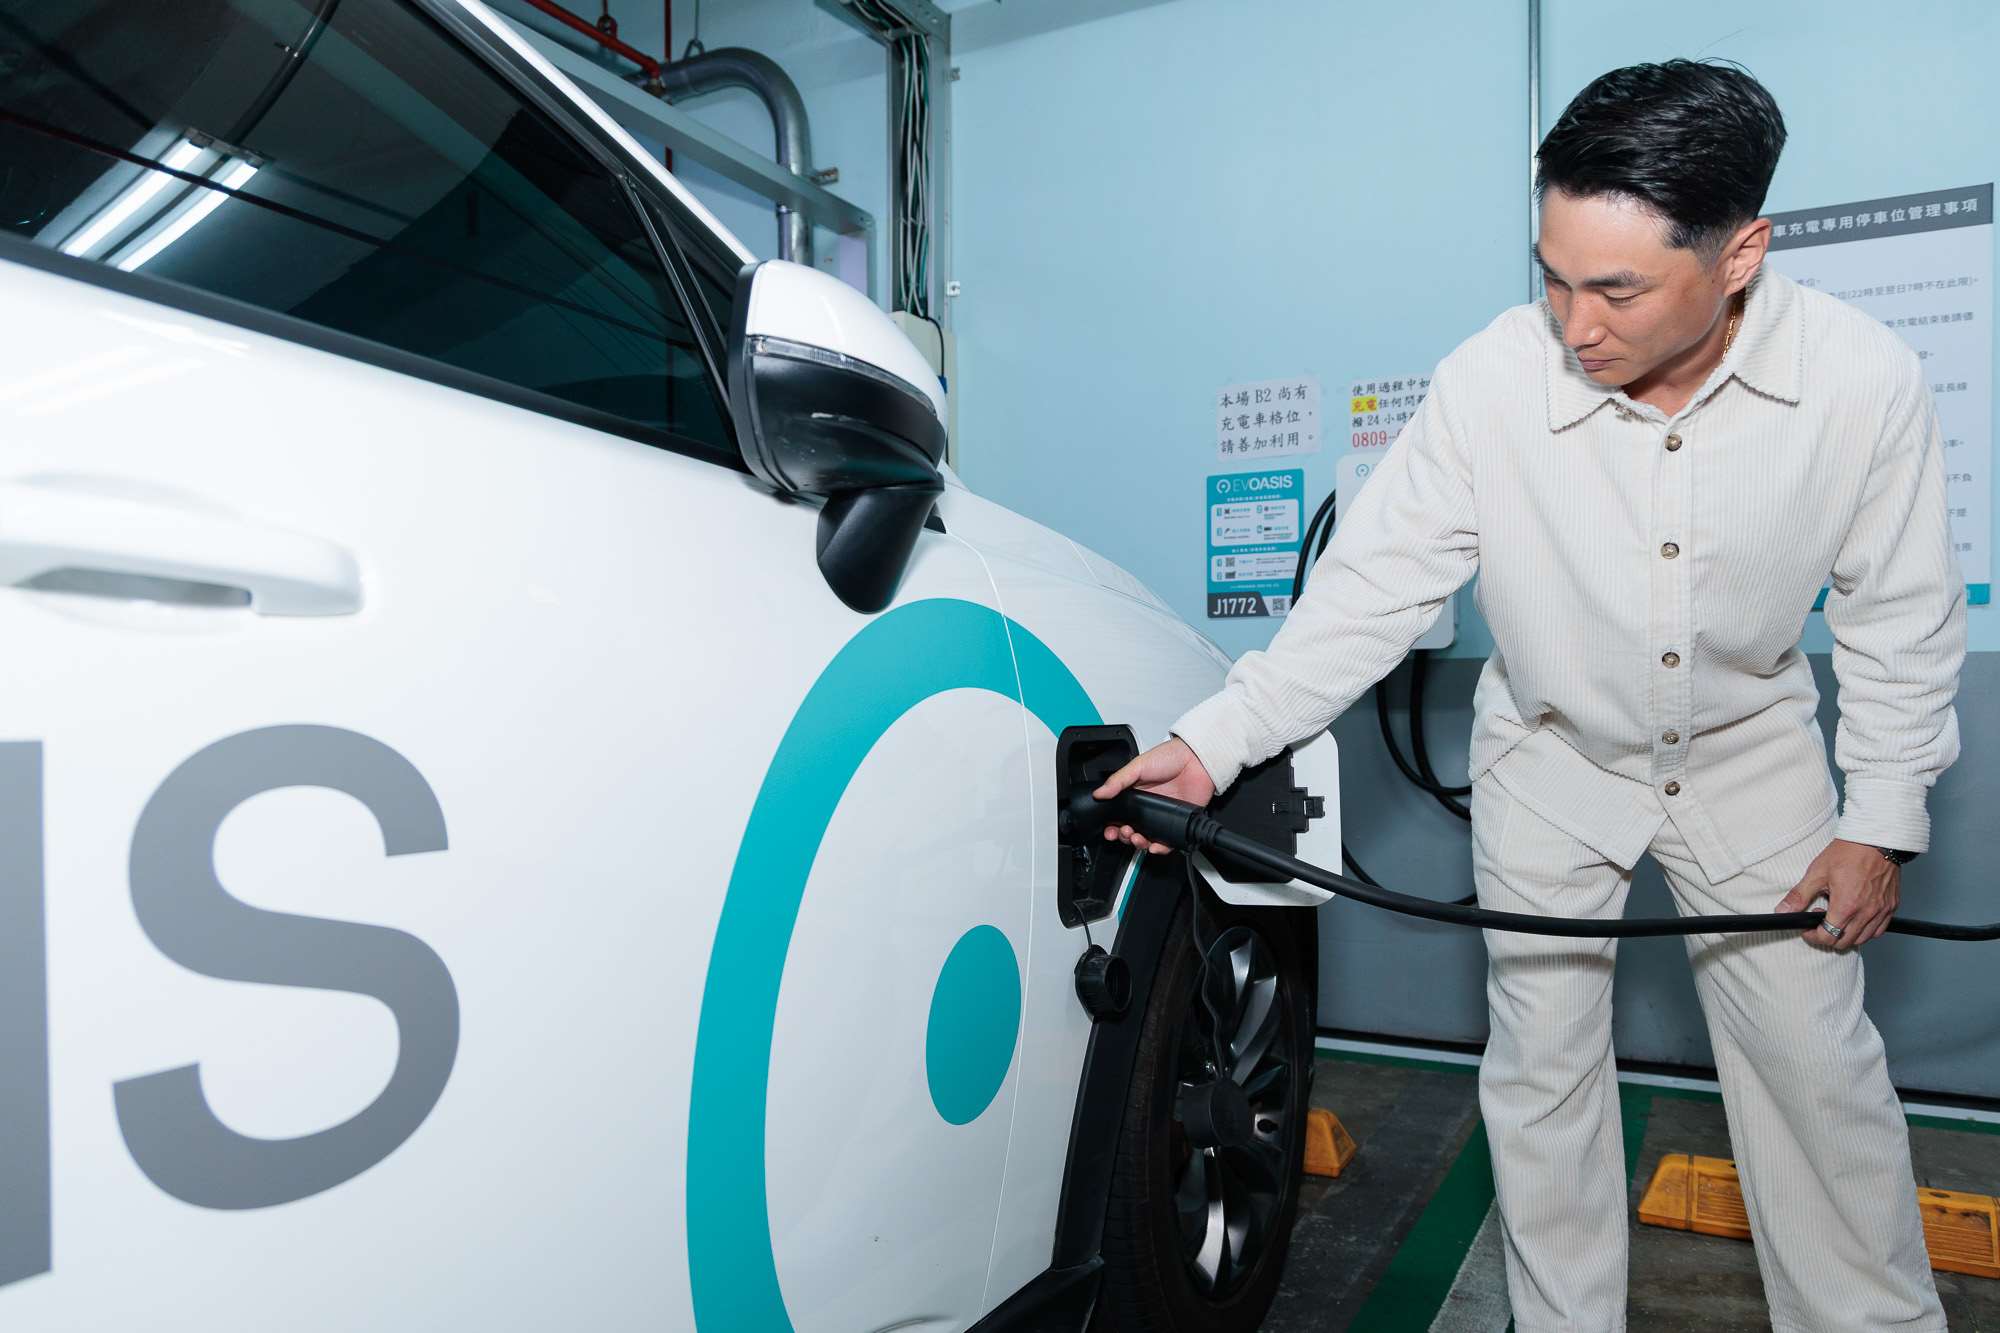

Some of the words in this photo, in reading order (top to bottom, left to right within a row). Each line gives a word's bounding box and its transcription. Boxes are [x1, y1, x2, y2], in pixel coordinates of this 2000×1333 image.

[1773, 198, 1978, 238] 車充電專用停車位管理事項
[1220, 390, 1249, 408] 本場
[1255, 387, 1272, 404] B2
[1278, 383, 1308, 401] 尚有
[1352, 378, 1430, 396] 使用過程中如
[1367, 415, 1379, 426] 24
[1220, 431, 1314, 455] 請善加利用。
[1232, 474, 1293, 492] EVOASIS
[1213, 597, 1257, 615] J1772
